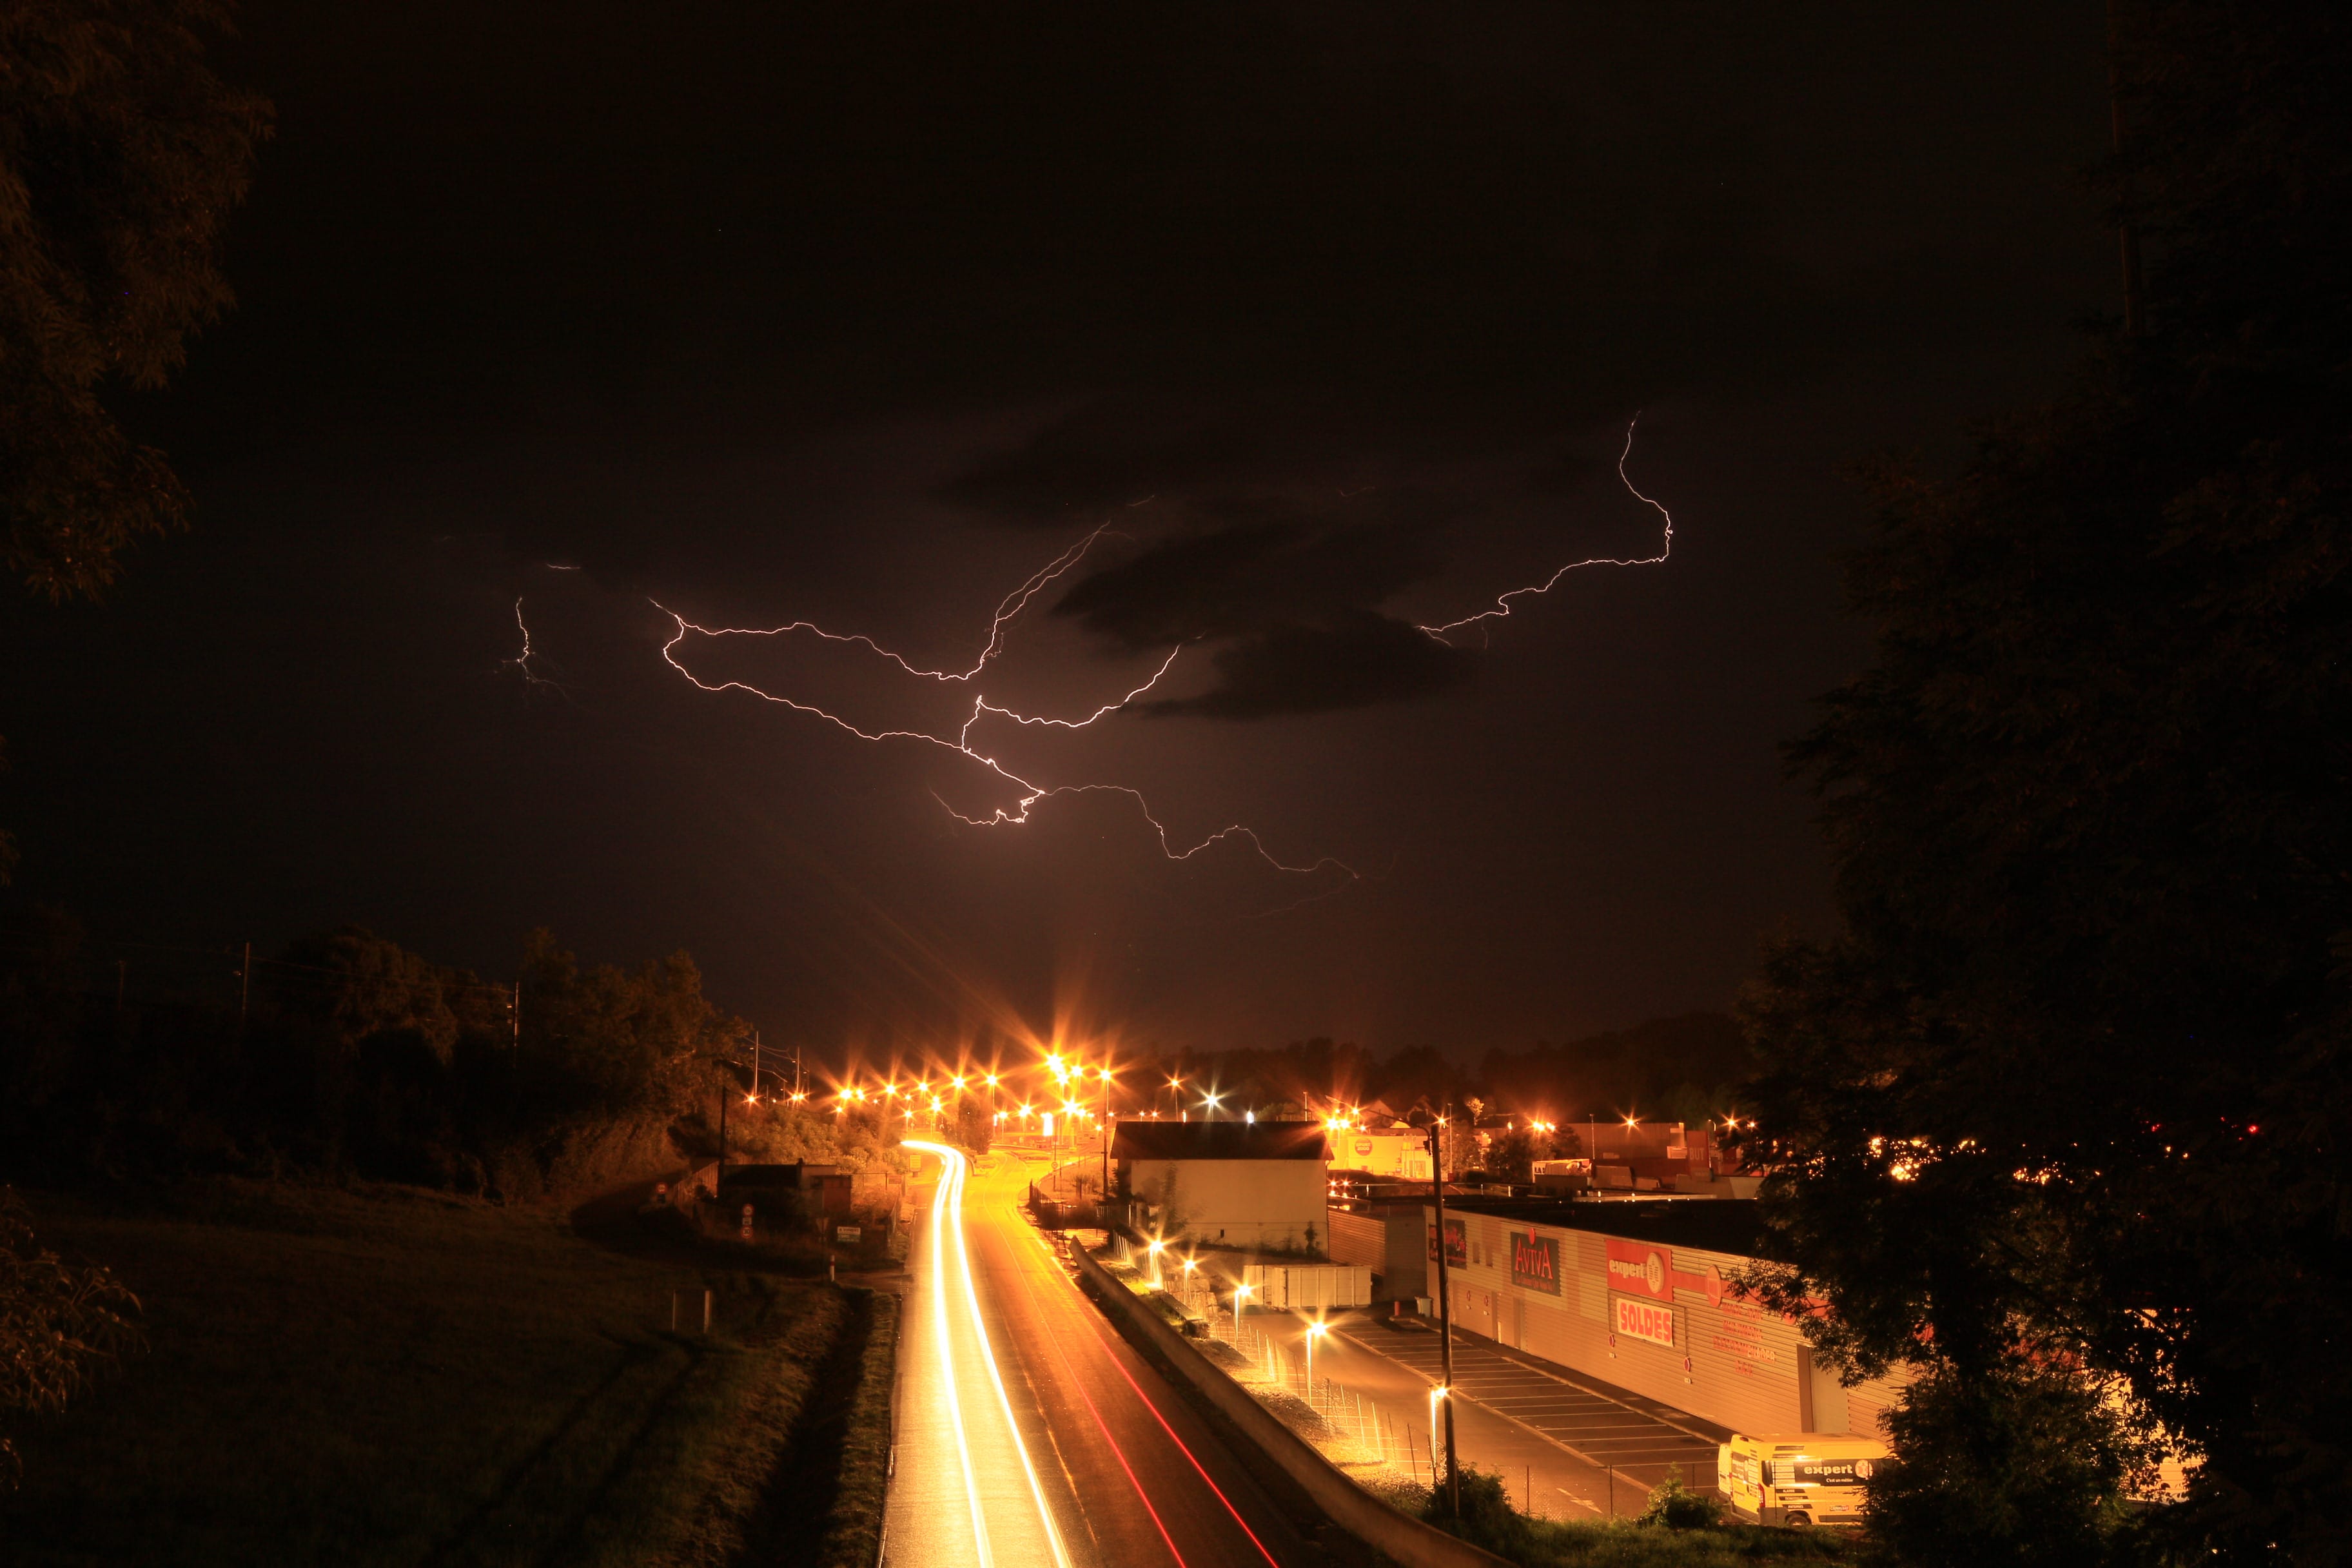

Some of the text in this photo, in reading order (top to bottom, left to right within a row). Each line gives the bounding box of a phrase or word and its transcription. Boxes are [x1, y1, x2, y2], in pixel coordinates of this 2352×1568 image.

[1689, 1148, 1704, 1160] BUT
[1514, 1237, 1553, 1280] AVIVA
[1609, 1259, 1645, 1279] expert
[1620, 1302, 1671, 1342] SOLDES
[1804, 1464, 1853, 1476] expert
